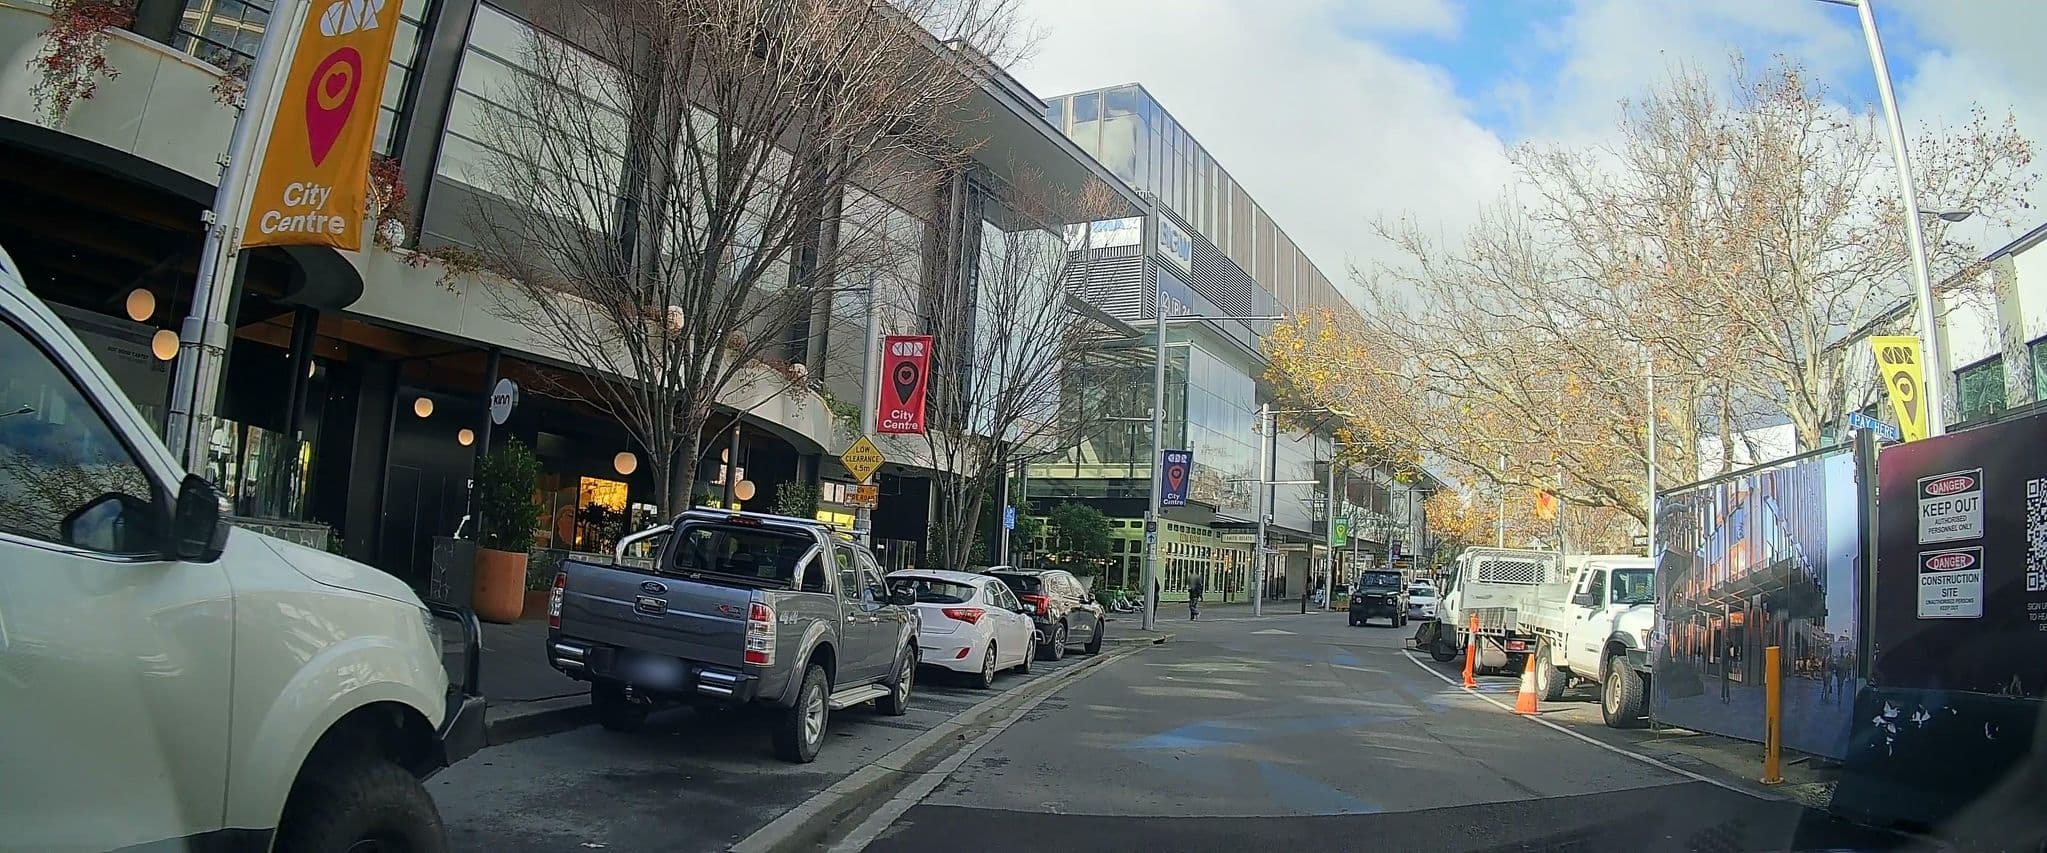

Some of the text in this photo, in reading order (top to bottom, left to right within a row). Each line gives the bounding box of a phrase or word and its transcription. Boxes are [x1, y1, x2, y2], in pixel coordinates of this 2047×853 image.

[282, 180, 333, 211] City
[260, 210, 346, 235] Centre
[891, 409, 914, 423] City
[882, 419, 919, 430] Centre
[1855, 415, 1896, 440] PAY HERE
[855, 446, 870, 454] LOW
[845, 454, 880, 464] CLEARANCE
[853, 464, 870, 473] 4.5m
[1933, 482, 1965, 494] DANGER
[1922, 497, 1979, 518] KEEP OUT
[1934, 515, 1968, 526] AUTHORISED
[1928, 523, 1972, 535] PERSONNEL ONLY
[1934, 557, 1966, 569] DANGER
[1921, 573, 1980, 586] CONSTRUCTION
[1941, 587, 1958, 598] SITE
[2027, 602, 2041, 611] SIGN
[2029, 612, 2037, 621] TO
